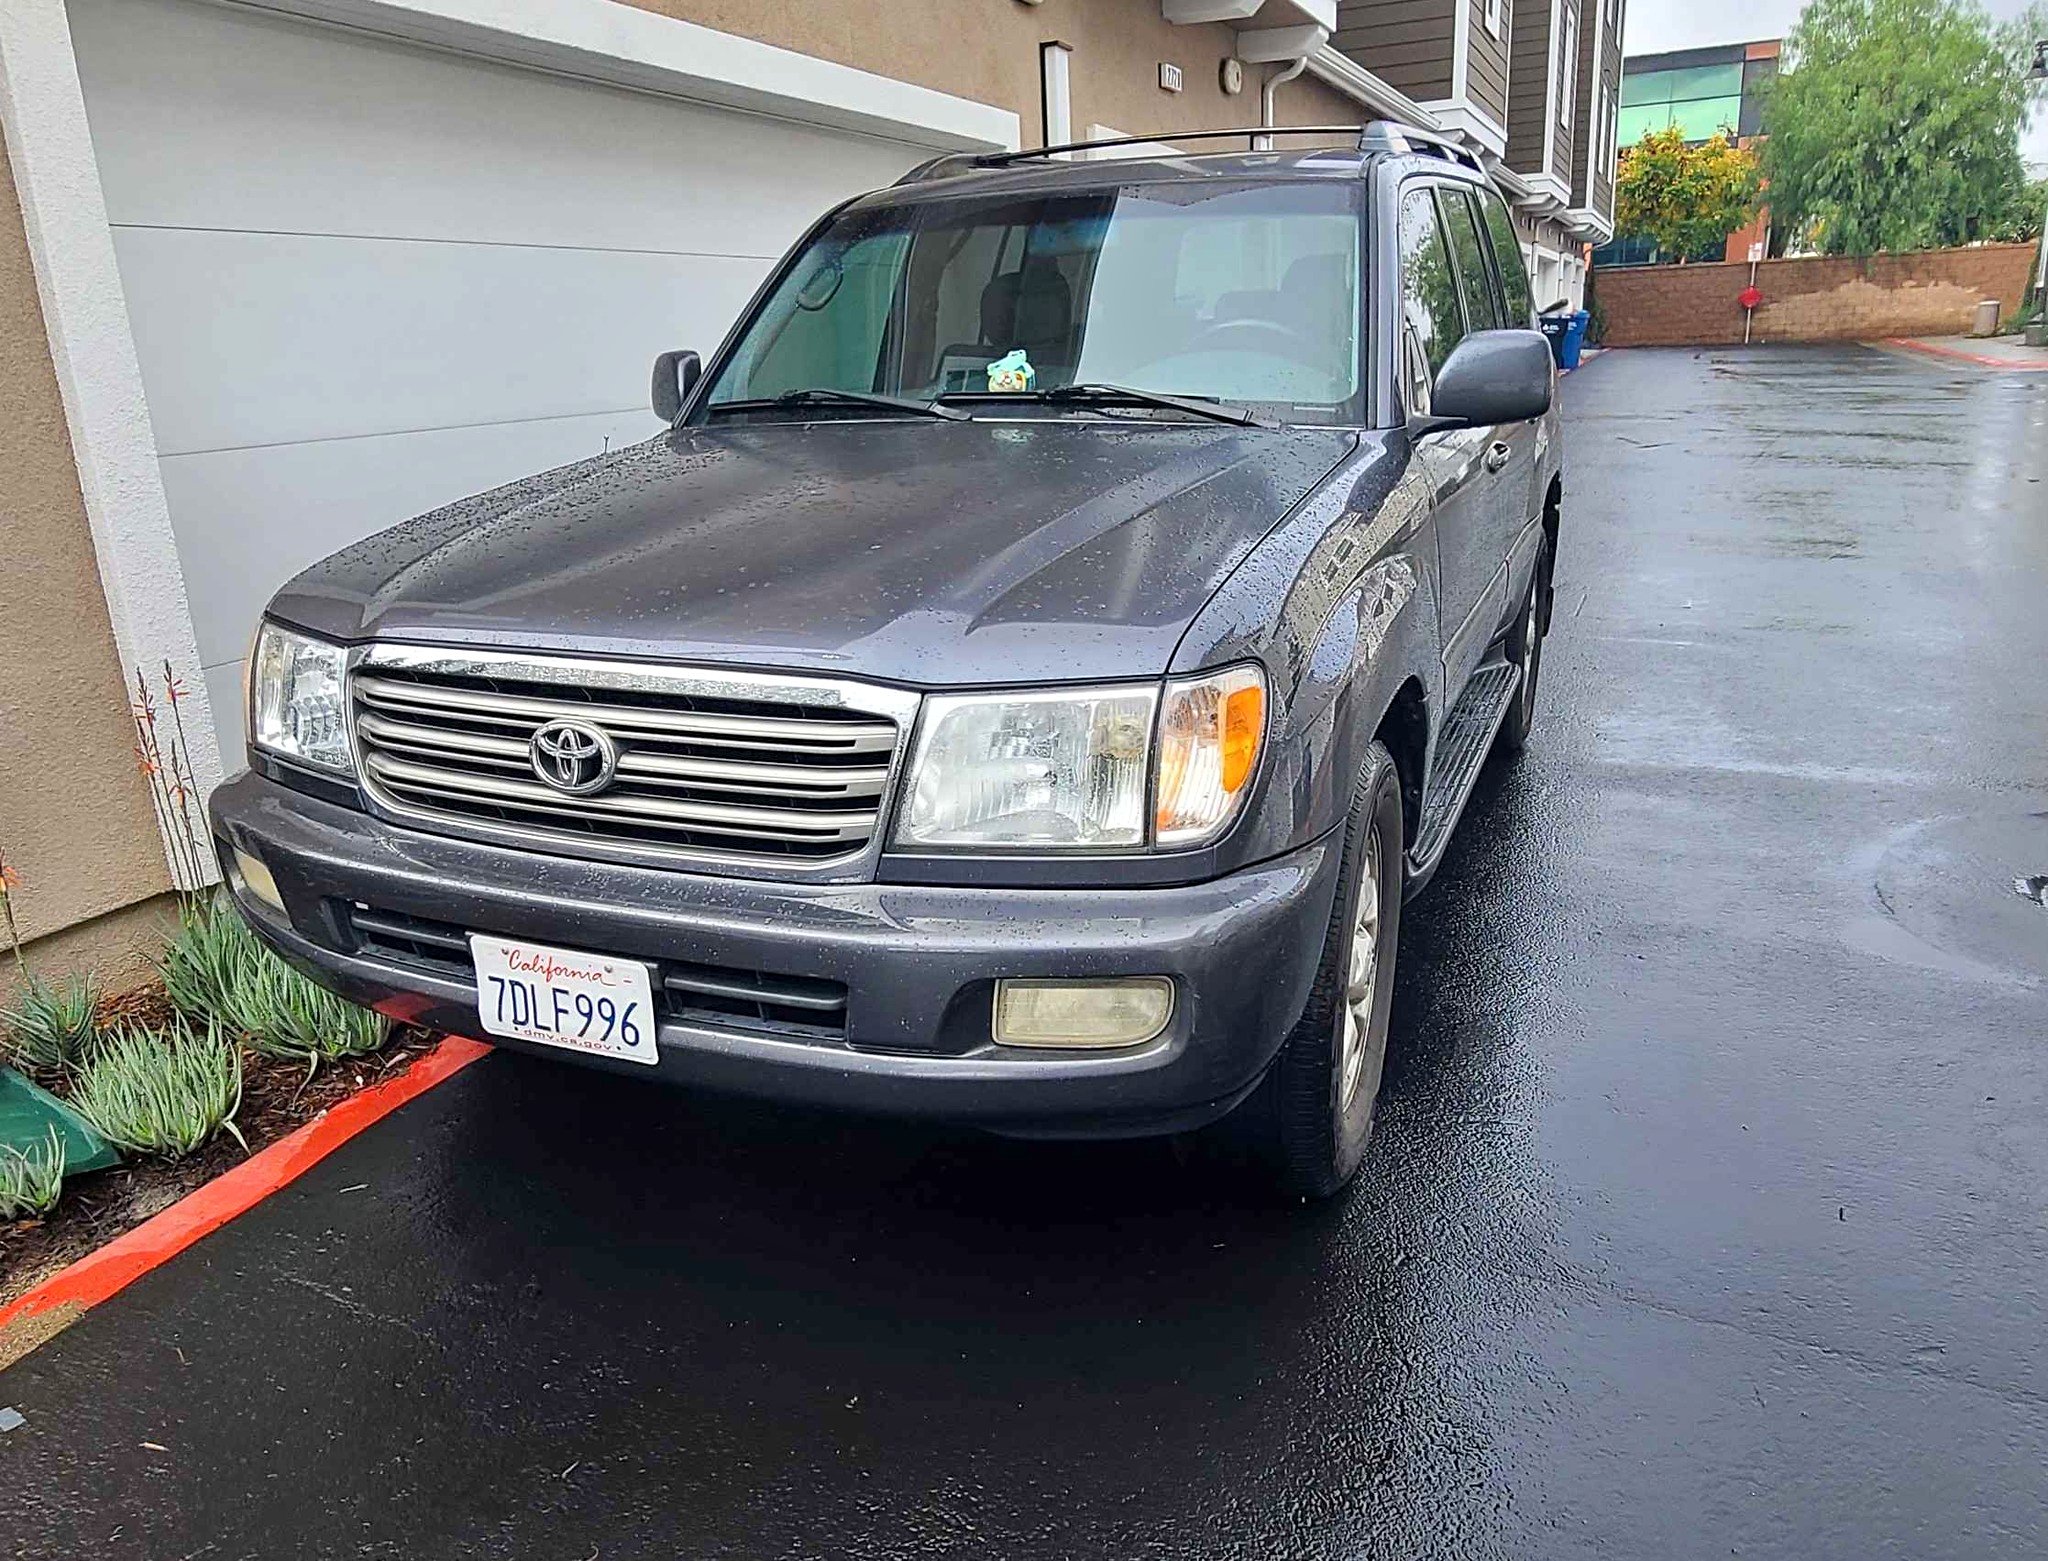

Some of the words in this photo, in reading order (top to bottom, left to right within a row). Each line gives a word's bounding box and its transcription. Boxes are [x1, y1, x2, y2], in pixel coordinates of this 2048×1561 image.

[508, 949, 616, 986] California
[488, 975, 640, 1047] 7DLF996
[523, 1028, 613, 1051] dmv.ca.gov
